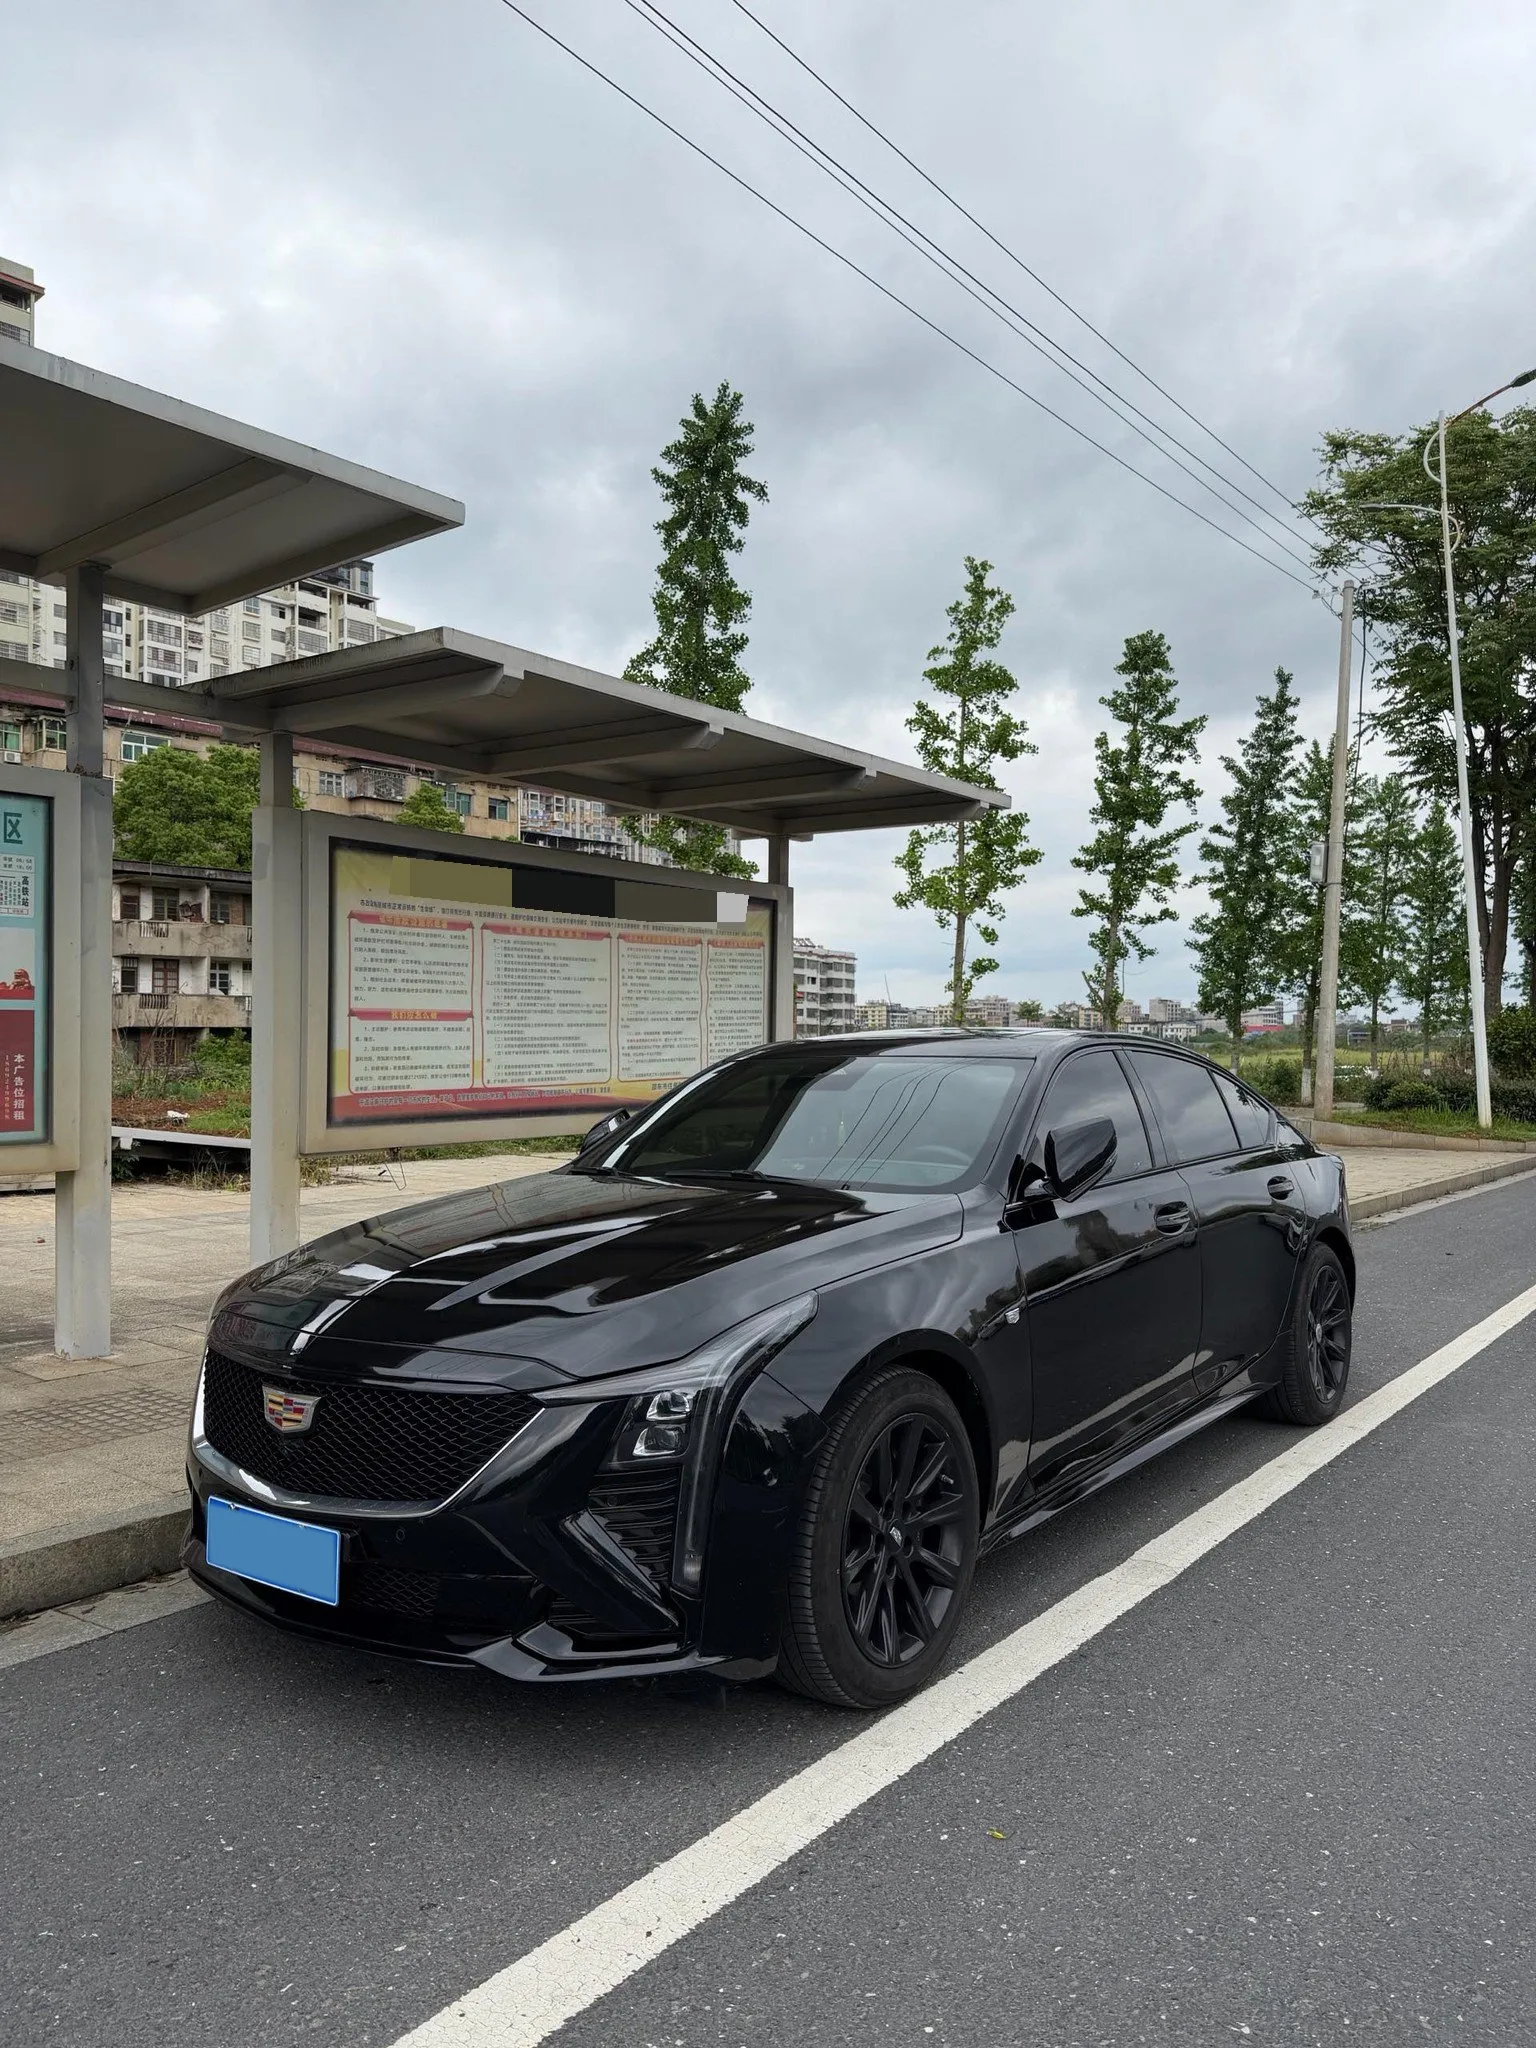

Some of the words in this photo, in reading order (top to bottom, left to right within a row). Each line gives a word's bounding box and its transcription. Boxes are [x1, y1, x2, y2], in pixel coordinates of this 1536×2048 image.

[4, 812, 23, 844] 区
[21, 876, 29, 907] 高铁站
[13, 1053, 25, 1120] 本广告位招租
